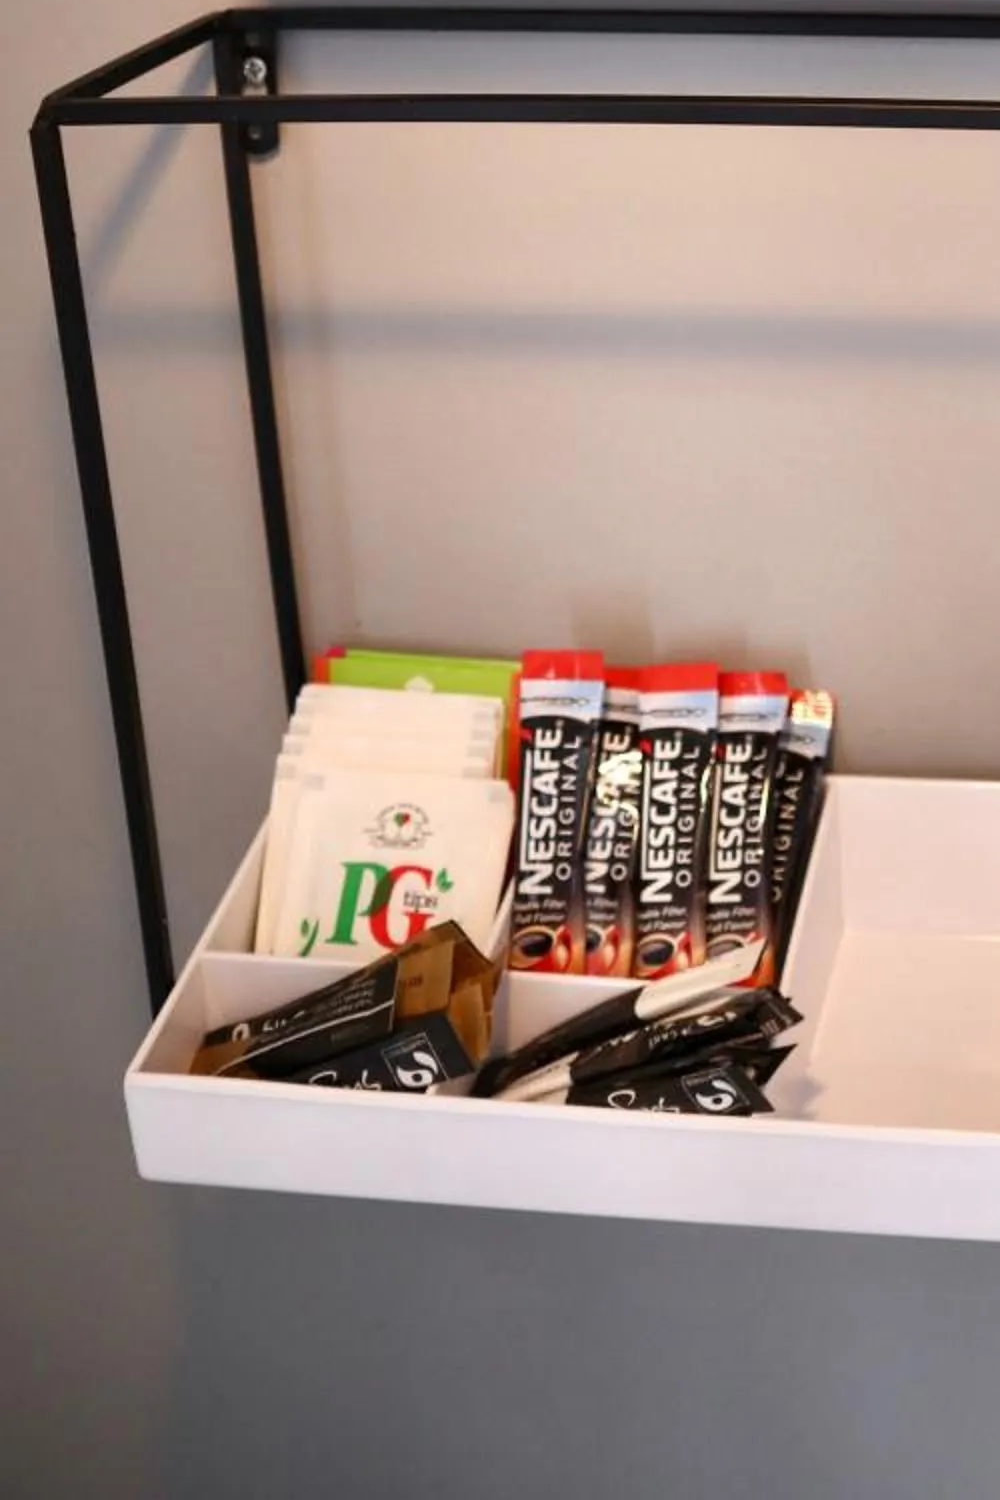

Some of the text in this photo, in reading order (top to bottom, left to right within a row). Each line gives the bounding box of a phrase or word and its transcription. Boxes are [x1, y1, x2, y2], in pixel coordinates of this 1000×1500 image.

[556, 735, 581, 882] ORIGINAL
[675, 747, 700, 888] ORIGINAL
[744, 747, 768, 887] ORIGINAL
[324, 860, 434, 952] PG
